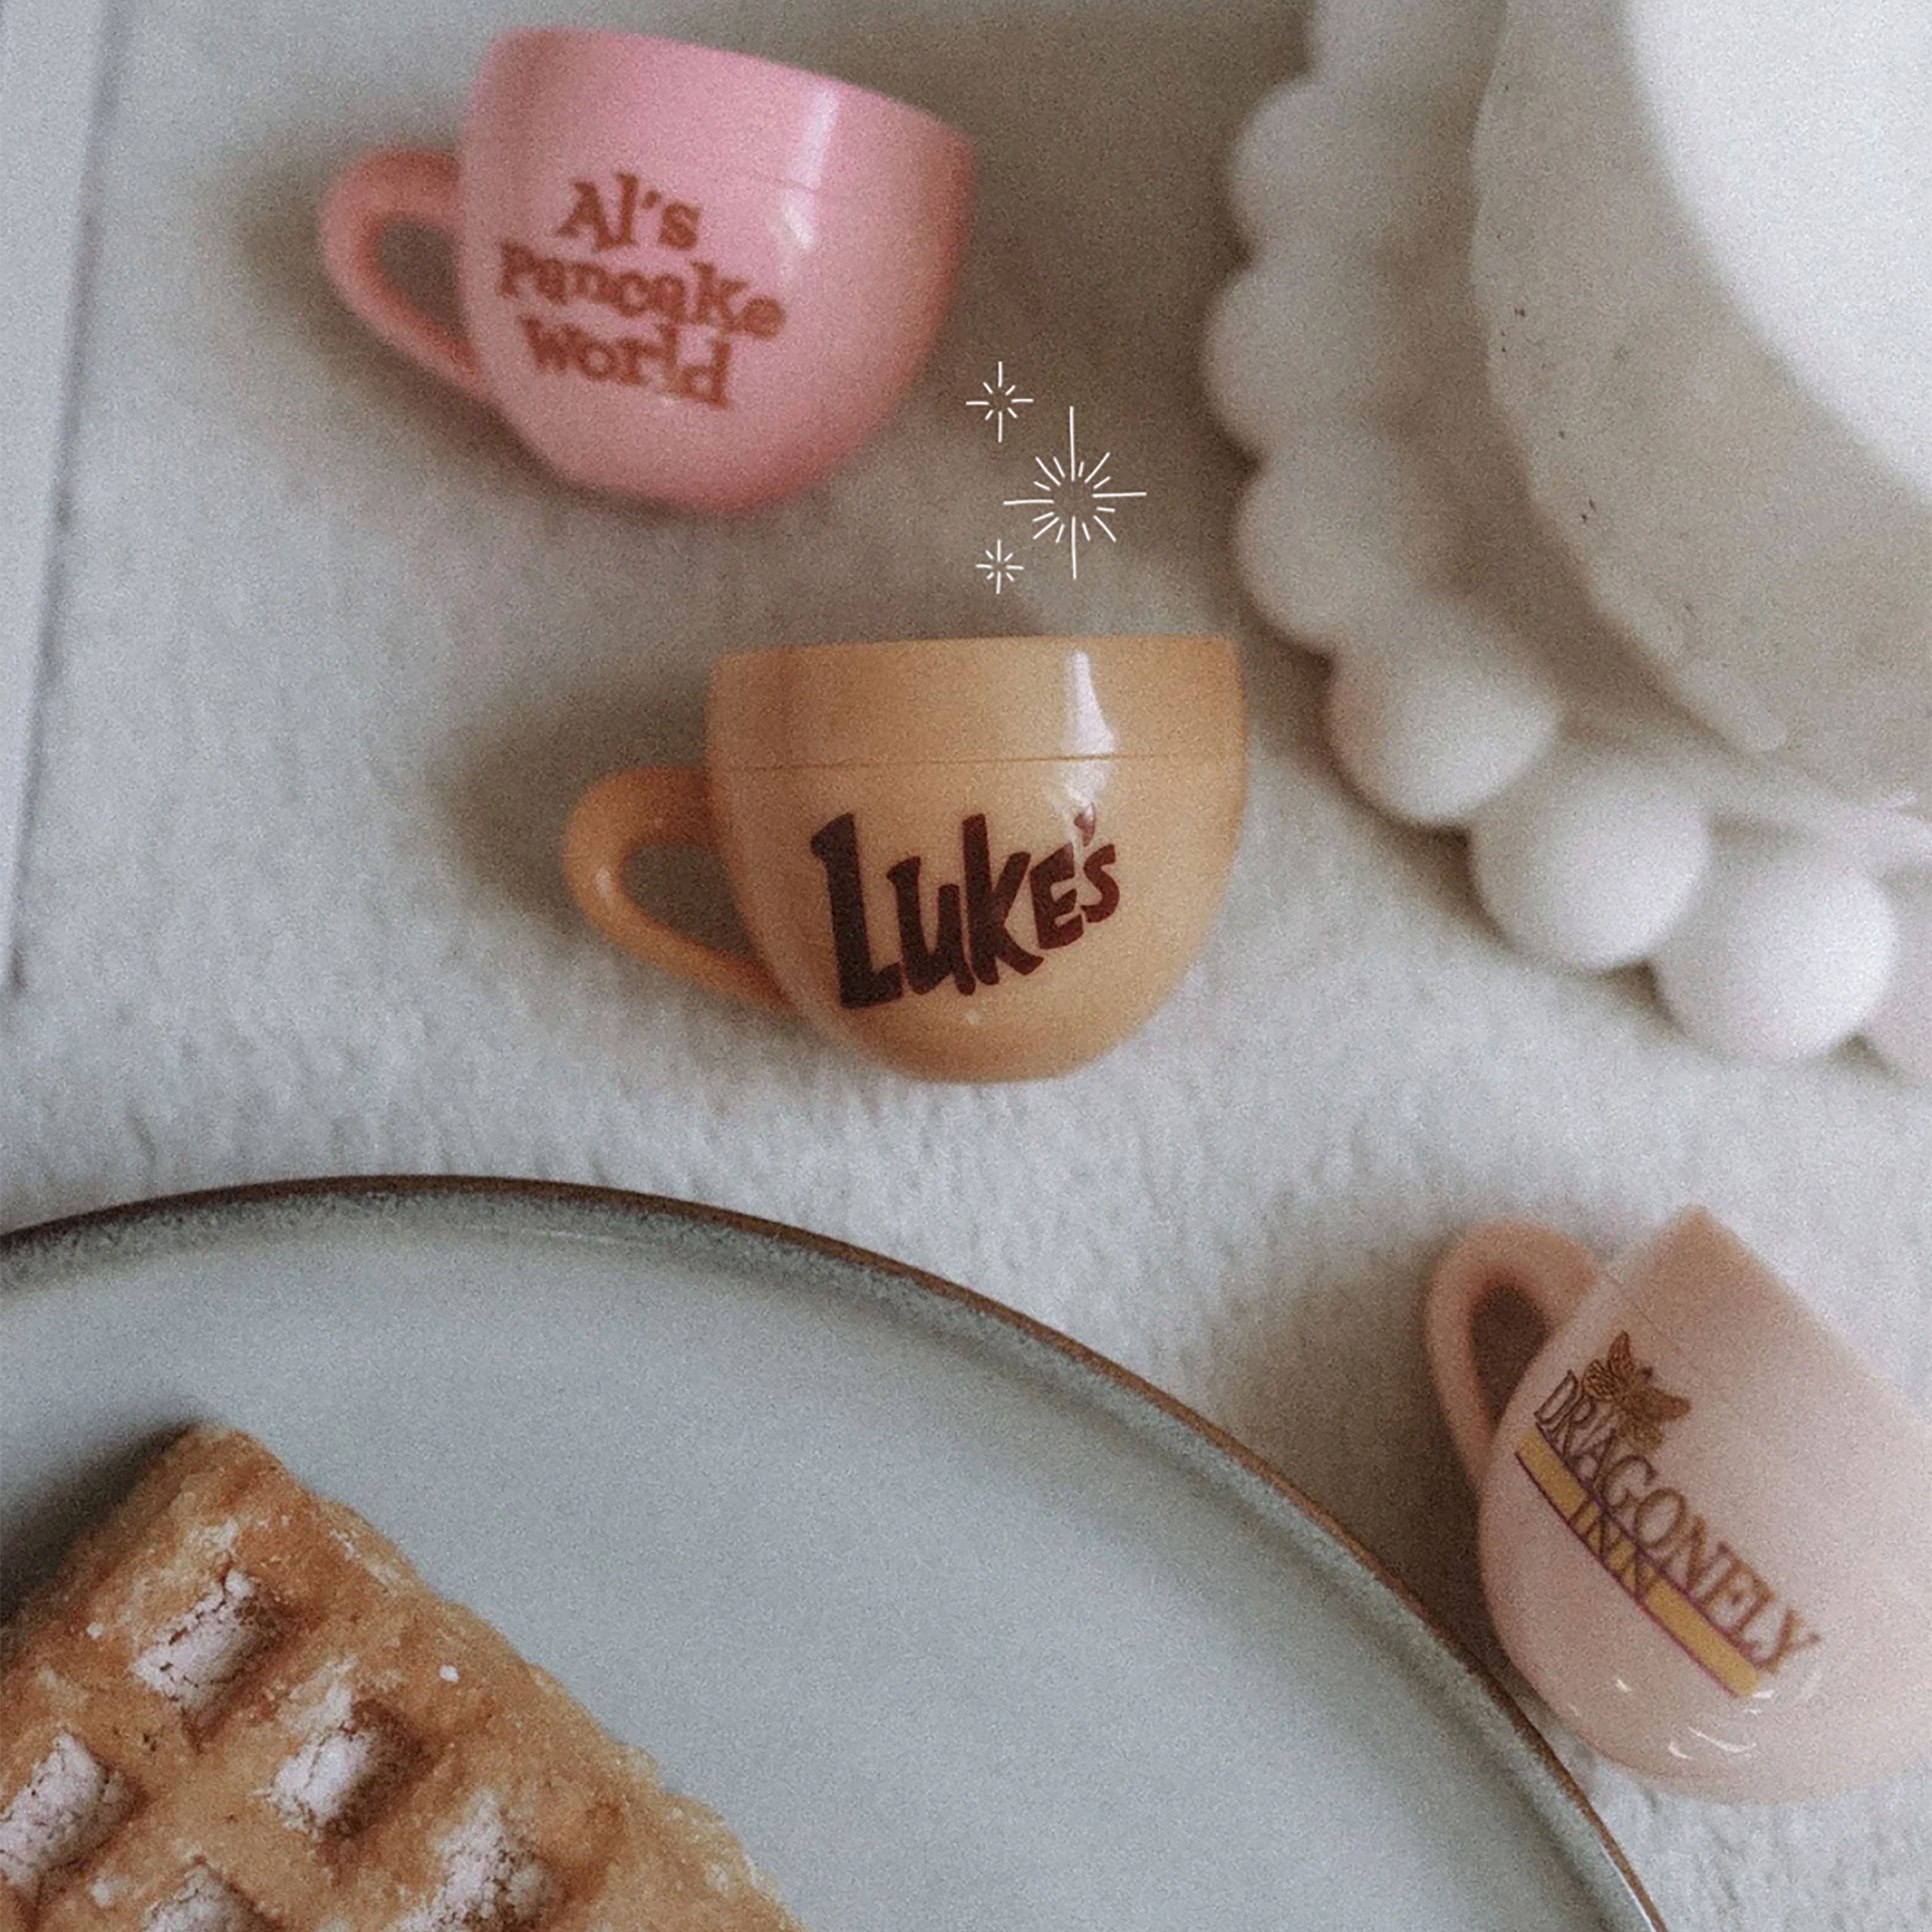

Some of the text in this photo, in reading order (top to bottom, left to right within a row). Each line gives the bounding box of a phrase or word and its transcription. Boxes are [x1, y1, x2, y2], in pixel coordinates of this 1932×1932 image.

[557, 173, 702, 251] Al's
[500, 242, 786, 339] Pancake
[520, 314, 733, 410] World
[1534, 1369, 1820, 1674] DRAGONFLY
[1568, 1497, 1659, 1601] INN
